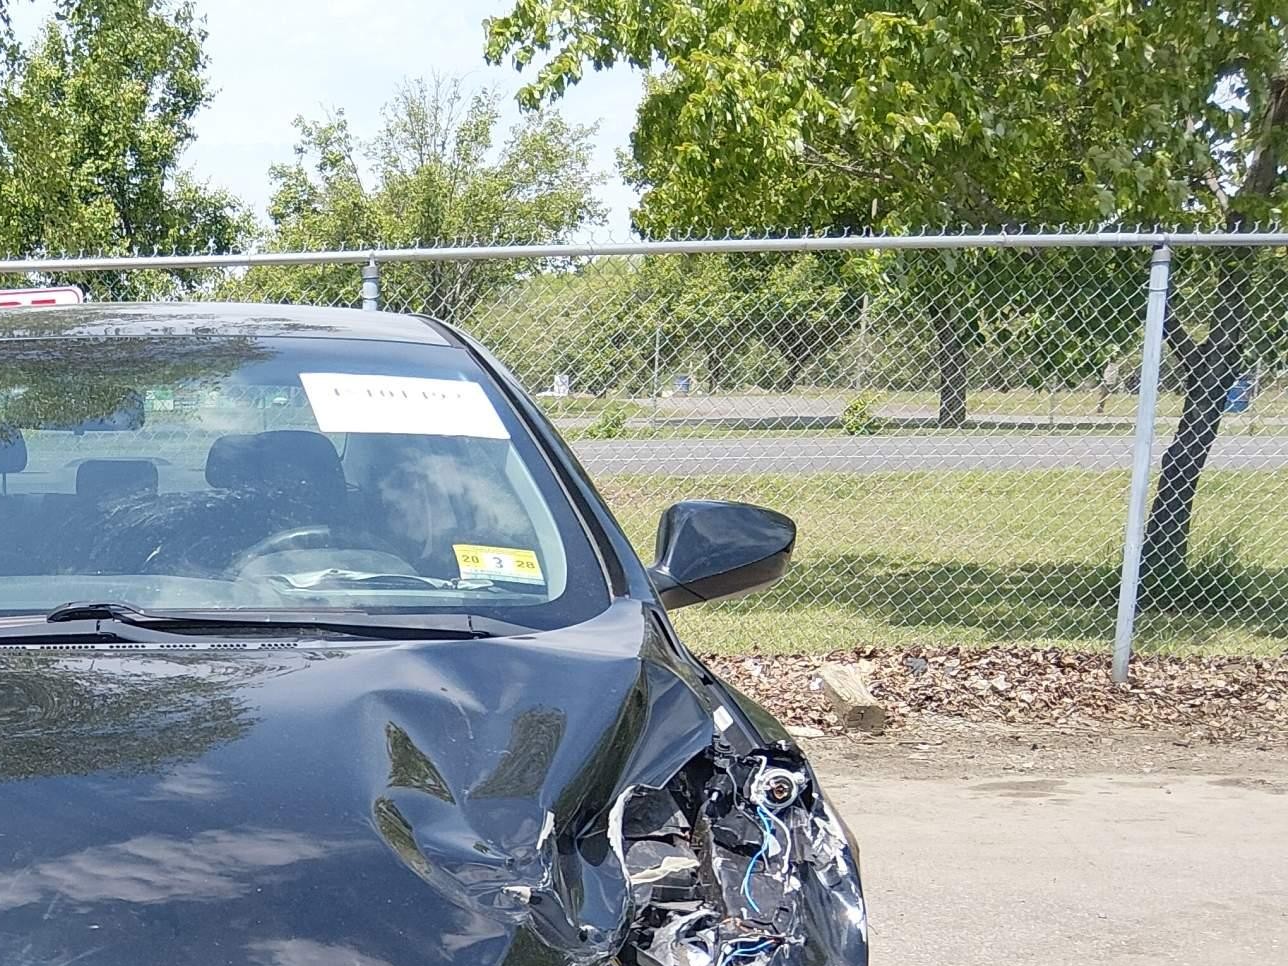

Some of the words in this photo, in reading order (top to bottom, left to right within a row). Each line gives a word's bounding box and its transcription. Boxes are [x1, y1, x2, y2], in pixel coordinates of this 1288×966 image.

[462, 554, 479, 564] 20
[492, 556, 504, 569] 3
[516, 560, 535, 569] 28
